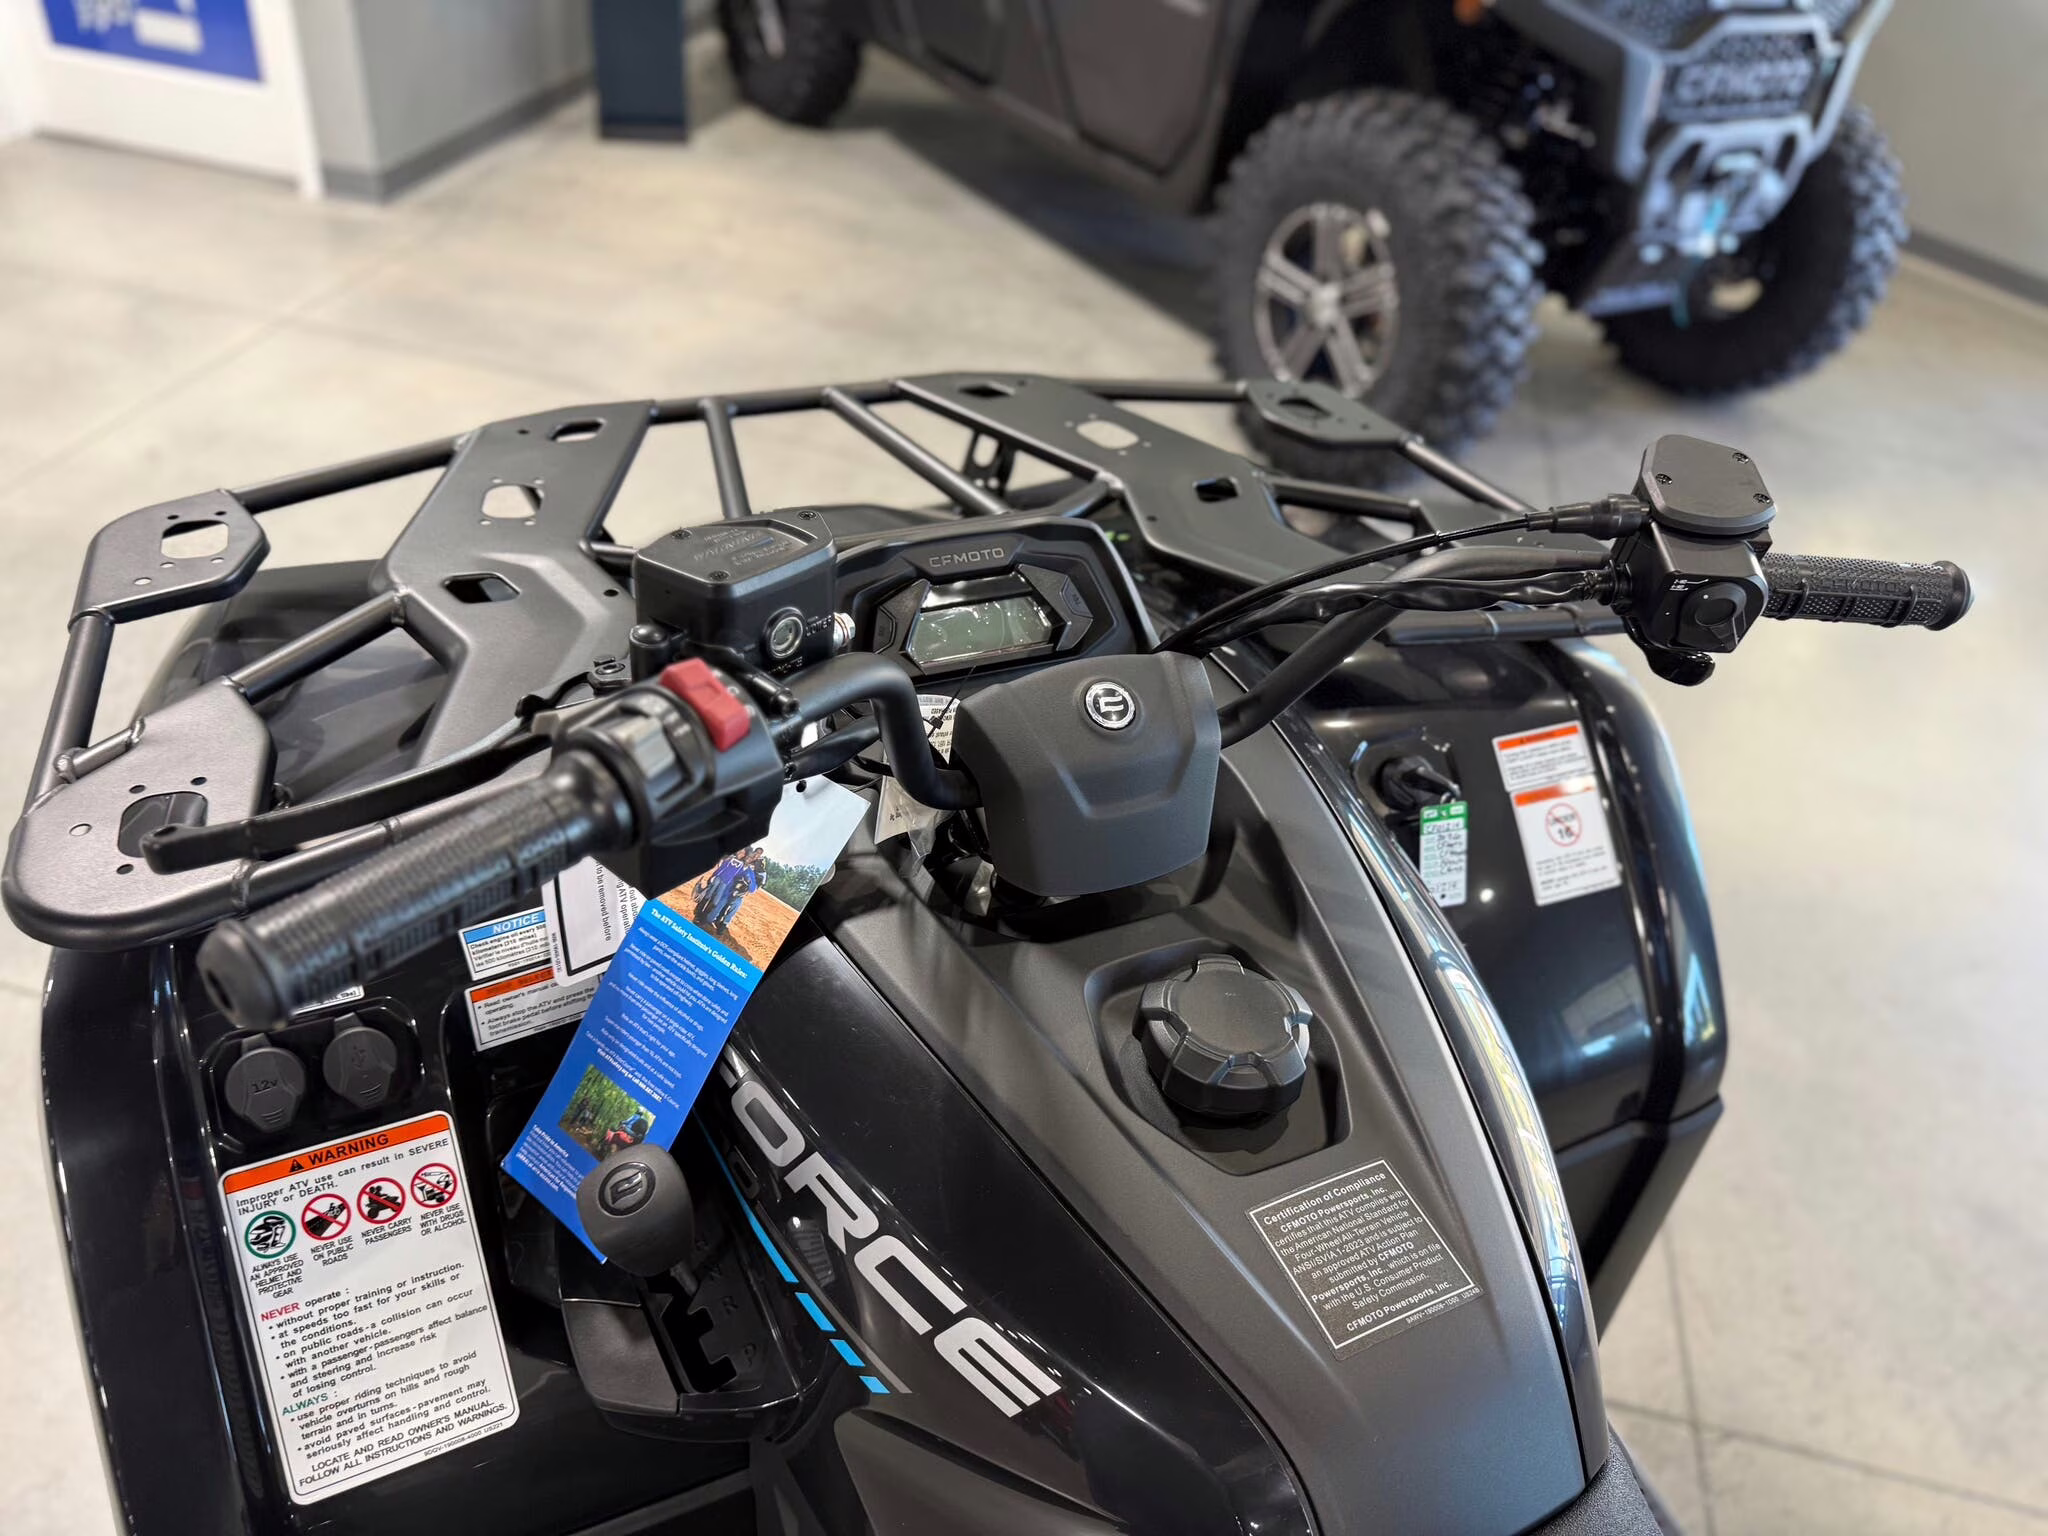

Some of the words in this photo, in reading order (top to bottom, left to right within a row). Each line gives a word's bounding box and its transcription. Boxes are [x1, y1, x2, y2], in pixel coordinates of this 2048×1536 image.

[929, 546, 1005, 568] CFMOTO
[598, 885, 608, 917] removed
[492, 912, 541, 934] NOTICE
[602, 916, 612, 942] before
[651, 908, 661, 918] The
[660, 915, 673, 925] ATV
[671, 922, 688, 937] Safety
[686, 933, 712, 954] Institute's
[711, 950, 731, 967] Golden
[729, 963, 747, 978] Rules:
[251, 1079, 278, 1093] 12v
[309, 1134, 390, 1165] WARNING
[236, 1188, 284, 1207] Improper
[289, 1179, 310, 1192] ATV
[314, 1174, 332, 1184] use
[337, 1167, 356, 1177] can
[361, 1156, 390, 1170] result
[408, 1138, 448, 1156] SEVERE
[238, 1197, 277, 1215] INJURY
[283, 1194, 294, 1202] or
[298, 1181, 338, 1197] DEATH.
[420, 1208, 444, 1221] NEVER
[446, 1202, 460, 1212] USE
[1263, 1197, 1323, 1224] Certification
[1322, 1191, 1333, 1201] of
[1332, 1173, 1386, 1196] Compliance
[1280, 1212, 1318, 1232] CFMOTO
[1317, 1193, 1373, 1217] Powersports,
[1370, 1187, 1387, 1196] Inc.
[361, 1225, 385, 1238] NEVER
[387, 1216, 412, 1229] CARRY
[419, 1218, 438, 1228] WITH
[439, 1209, 464, 1223] DRUGS
[420, 1227, 432, 1236] OR
[434, 1217, 467, 1232] ALCOHOL
[1274, 1229, 1307, 1247] certifies
[1306, 1221, 1324, 1233] that
[1322, 1216, 1339, 1226] this
[1338, 1208, 1354, 1220] ATV
[1354, 1196, 1389, 1213] complies
[1387, 1190, 1405, 1200] with
[1280, 1246, 1295, 1256] the
[1294, 1230, 1332, 1251] American
[1331, 1215, 1365, 1234] National
[1363, 1202, 1399, 1220] Standard
[1397, 1199, 1409, 1207] for
[310, 1241, 336, 1254] NEVER
[337, 1235, 353, 1245] USE
[364, 1225, 412, 1245] PASSENGERS
[1294, 1236, 1342, 1262] Four-Wheel
[1341, 1221, 1381, 1242] All-Terrain
[1379, 1210, 1409, 1225] Vehicle
[1336, 1238, 1365, 1255] 1-2023
[1364, 1232, 1380, 1244] and
[1378, 1230, 1388, 1238] is
[1387, 1218, 1415, 1234] subject
[252, 1258, 281, 1273] ALWAYS
[283, 1252, 298, 1263] USE
[312, 1252, 324, 1261] ON
[326, 1243, 354, 1257] PUBLIC
[322, 1253, 348, 1266] ROADS
[1311, 1270, 1322, 1279] an
[1322, 1252, 1360, 1274] approved
[1359, 1244, 1375, 1258] ATV
[1376, 1236, 1401, 1251] Action
[1399, 1229, 1418, 1240] Plan
[1328, 1260, 1368, 1283] submitted
[1366, 1257, 1378, 1266] by
[1377, 1241, 1414, 1261] CFMOTO
[250, 1273, 261, 1282] AN
[263, 1259, 304, 1277] APPROVED
[255, 1273, 283, 1288] HELMET
[286, 1268, 302, 1278] AND
[258, 1275, 303, 1295] PROTECTIVE
[1311, 1274, 1370, 1303] Powersports,
[1387, 1255, 1412, 1269] which
[1409, 1252, 1418, 1260] is
[1418, 1248, 1429, 1256] on
[1427, 1243, 1441, 1252] file
[1322, 1298, 1342, 1310] with
[1340, 1292, 1355, 1302] the
[1354, 1283, 1374, 1295] U.S.
[1373, 1266, 1413, 1287] Consumer
[1412, 1253, 1443, 1270] Product
[261, 1302, 300, 1321] NEVER
[304, 1291, 341, 1307] operate
[272, 1287, 293, 1298] GEAR
[276, 1310, 314, 1328] without
[318, 1299, 350, 1315] proper
[354, 1285, 392, 1302] training
[396, 1280, 407, 1288] or
[411, 1263, 464, 1284] instruction.
[278, 1330, 288, 1339] at
[293, 1317, 328, 1334] speeds
[333, 1310, 349, 1320] too
[353, 1301, 372, 1313] fast
[376, 1296, 390, 1306] for
[394, 1287, 416, 1301] your
[421, 1278, 446, 1291] skills
[450, 1273, 459, 1281] or
[1346, 1309, 1384, 1331] CFMOTO
[1382, 1288, 1437, 1314] Powersports,
[1435, 1281, 1452, 1291] Inc.
[1351, 1293, 1379, 1310] Safety
[1378, 1273, 1429, 1297] Commission.
[280, 1339, 296, 1349] the
[301, 1319, 356, 1341] conditions.
[285, 1356, 306, 1368] with
[311, 1342, 349, 1360] another
[353, 1329, 391, 1345] vehicle.
[282, 1392, 328, 1416] ALWAYS
[306, 1438, 351, 1459] seriously
[356, 1426, 384, 1441] affect
[387, 1409, 429, 1429] handling
[434, 1399, 451, 1412] and
[455, 1386, 490, 1404] control.
[311, 1452, 350, 1472] LOCATE
[353, 1443, 374, 1457] AND
[377, 1432, 404, 1448] READ
[407, 1414, 450, 1436] OWNER'S
[454, 1399, 494, 1419] MANUAL.
[299, 1465, 339, 1487] FOLLOW
[343, 1459, 362, 1471] ALL
[365, 1431, 432, 1462] INSTRUCTIONS
[435, 1423, 454, 1436] AND
[457, 1403, 507, 1426] WARNINGS.
